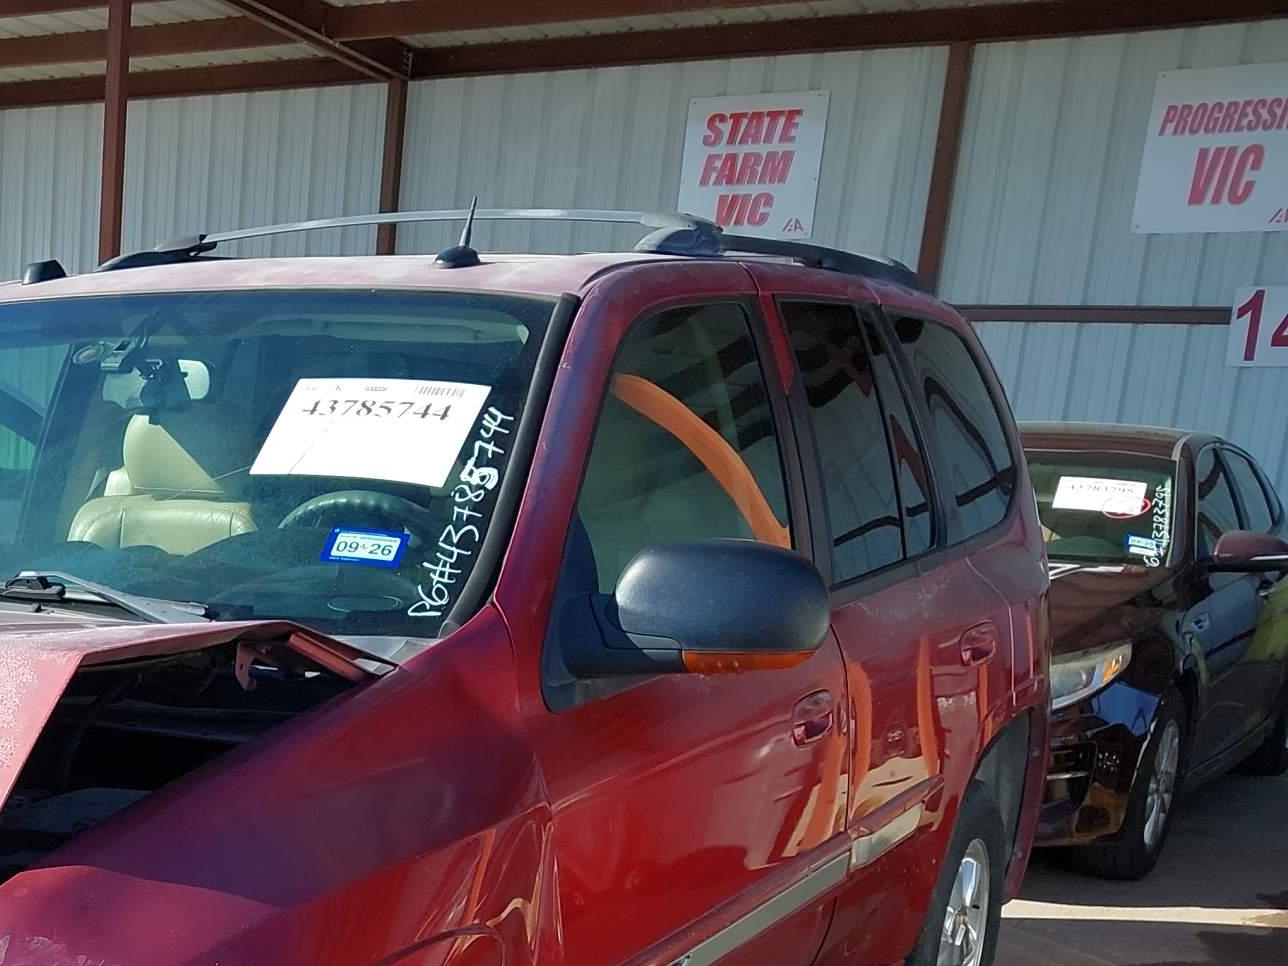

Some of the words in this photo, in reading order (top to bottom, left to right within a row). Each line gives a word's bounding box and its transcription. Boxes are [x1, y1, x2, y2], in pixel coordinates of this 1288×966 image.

[702, 109, 804, 147] STATE
[699, 150, 795, 187] FARM
[1187, 143, 1264, 206] VIC
[715, 192, 774, 227] VIC
[302, 399, 452, 421] 43785744
